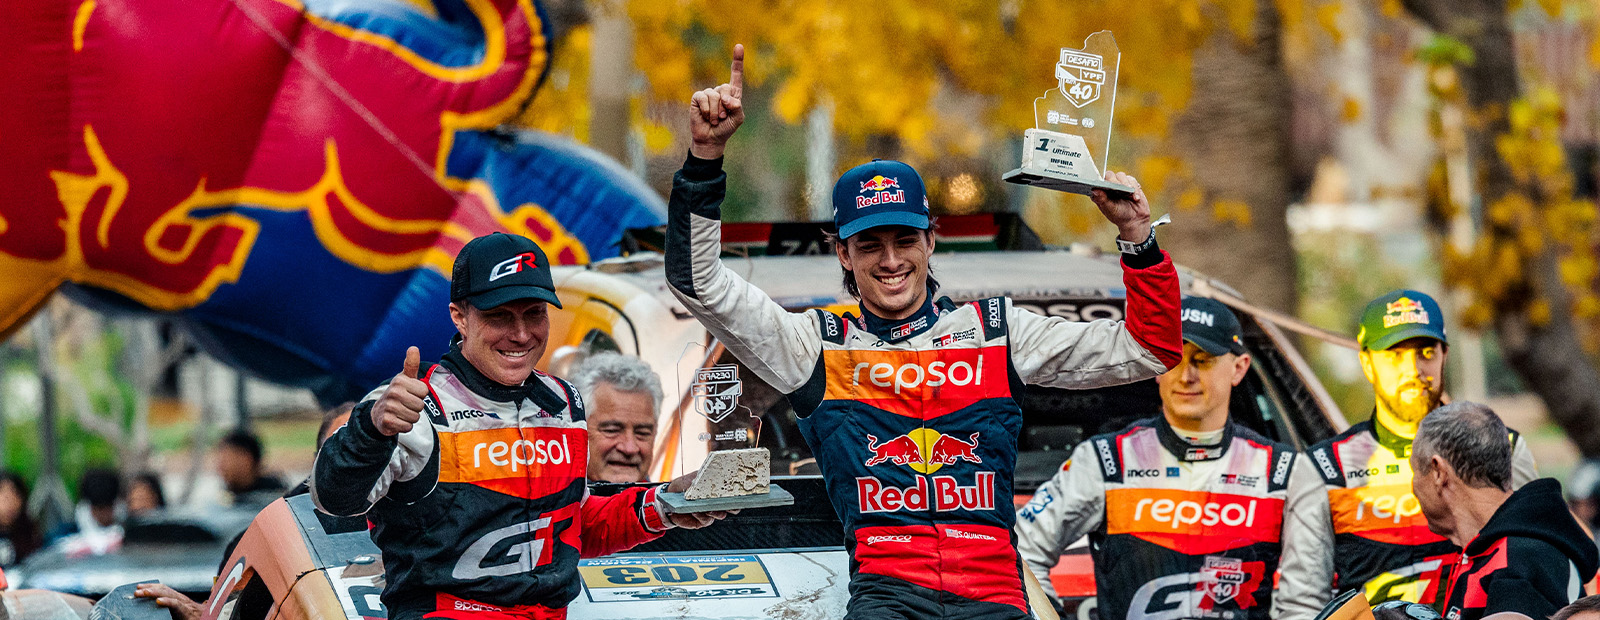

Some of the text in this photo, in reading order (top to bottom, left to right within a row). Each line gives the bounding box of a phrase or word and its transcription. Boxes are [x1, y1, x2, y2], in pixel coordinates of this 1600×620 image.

[1082, 71, 1103, 80] YPF
[1069, 82, 1093, 100] 40
[856, 192, 880, 209] Red
[881, 190, 906, 204] Bull
[489, 251, 538, 282] GR
[852, 354, 983, 394] repsol
[473, 434, 571, 472] repsol
[855, 471, 996, 514] Red Bull
[1134, 498, 1257, 529] repsol
[1356, 493, 1421, 524] rep
[867, 534, 912, 546] sparco
[602, 564, 746, 585] 203
[1212, 582, 1233, 598] 40
